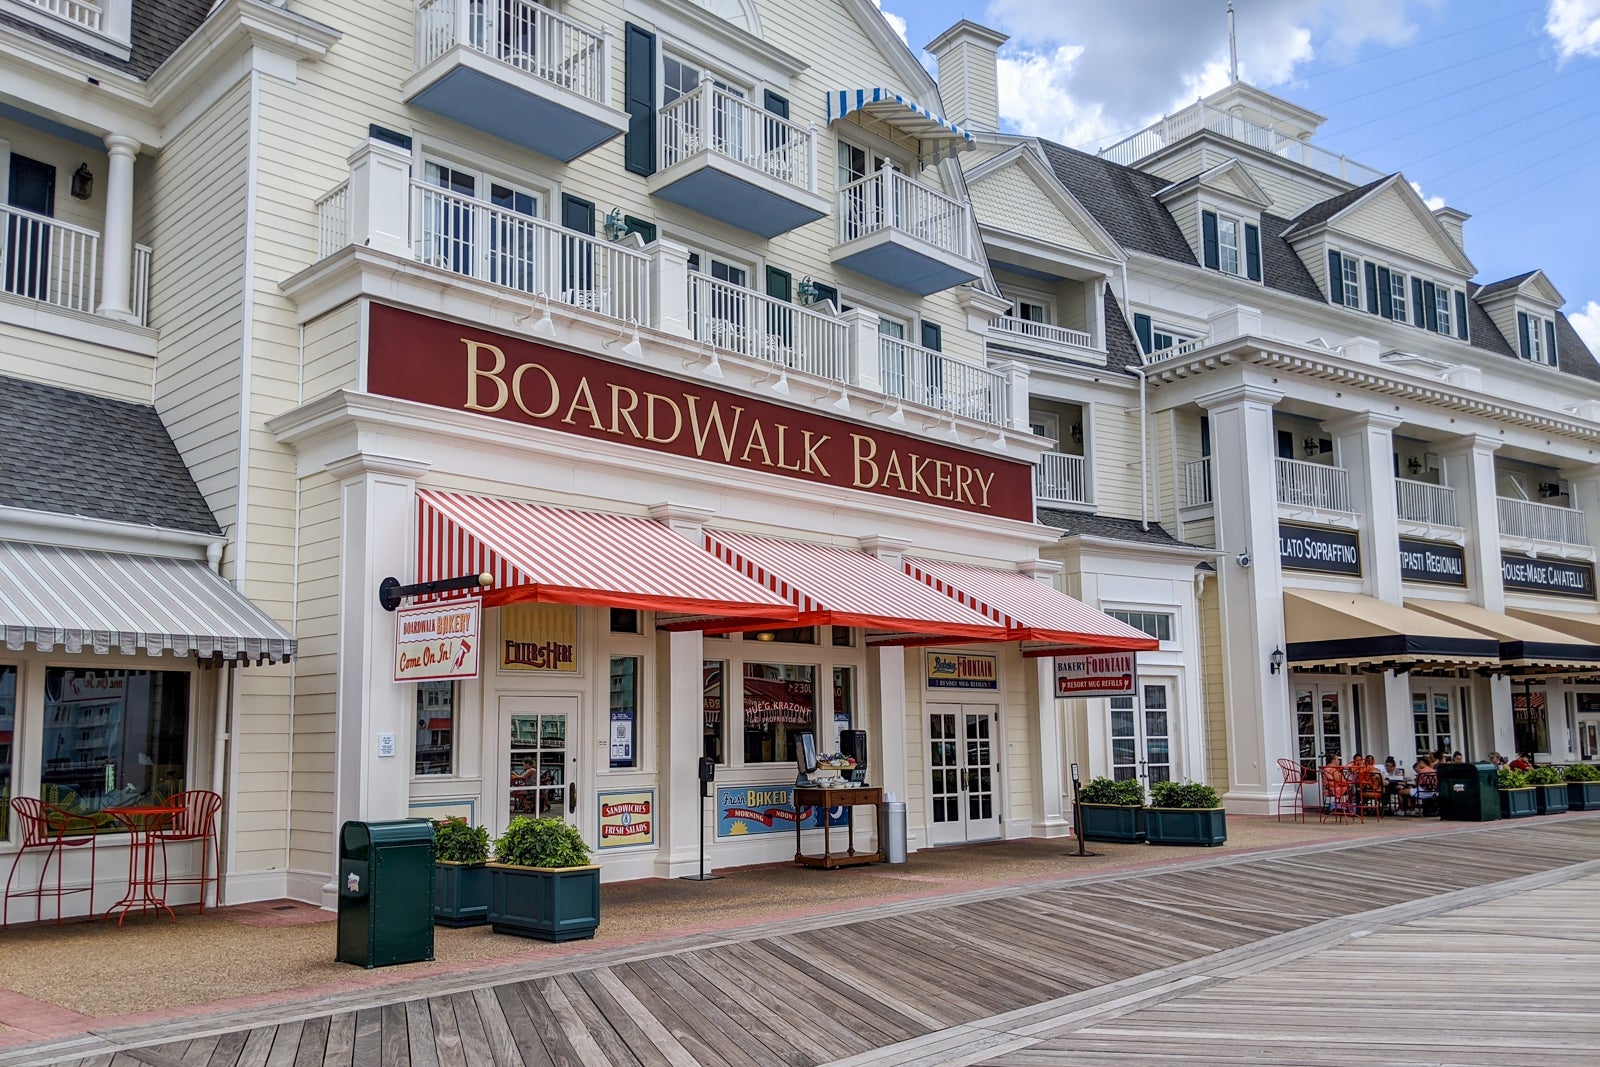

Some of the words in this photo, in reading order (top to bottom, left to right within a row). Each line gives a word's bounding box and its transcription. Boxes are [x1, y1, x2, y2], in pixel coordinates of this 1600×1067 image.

[459, 338, 831, 477] BOARDWALK
[850, 434, 995, 508] BAKERY
[1280, 537, 1303, 558] LATO
[1304, 537, 1357, 564] SOPRAFFINO
[1425, 551, 1462, 575] REGIONALI
[1547, 567, 1584, 588] CAVATELLI
[403, 619, 436, 635] BOARDWALK
[437, 613, 471, 636] BAKERY
[400, 652, 421, 672] Come
[423, 646, 436, 666] On
[437, 641, 453, 663] In!
[505, 640, 546, 668] ENTER
[538, 641, 573, 669] HERE
[1057, 661, 1086, 672] BAKERY
[1085, 655, 1131, 675] FOUNTAIN
[957, 656, 993, 678] FOUNTAIN
[1067, 681, 1088, 689] RESORT
[1088, 680, 1101, 688] MUG
[1101, 679, 1123, 687] REFILLS
[723, 791, 746, 806] Fresh
[747, 790, 788, 808] BAKED
[606, 804, 646, 816] SANDWICHES
[623, 814, 630, 824] &
[734, 810, 764, 822] MORNING
[776, 810, 793, 820] NOON
[605, 825, 624, 835] FRESH
[625, 822, 648, 835] SALADS
